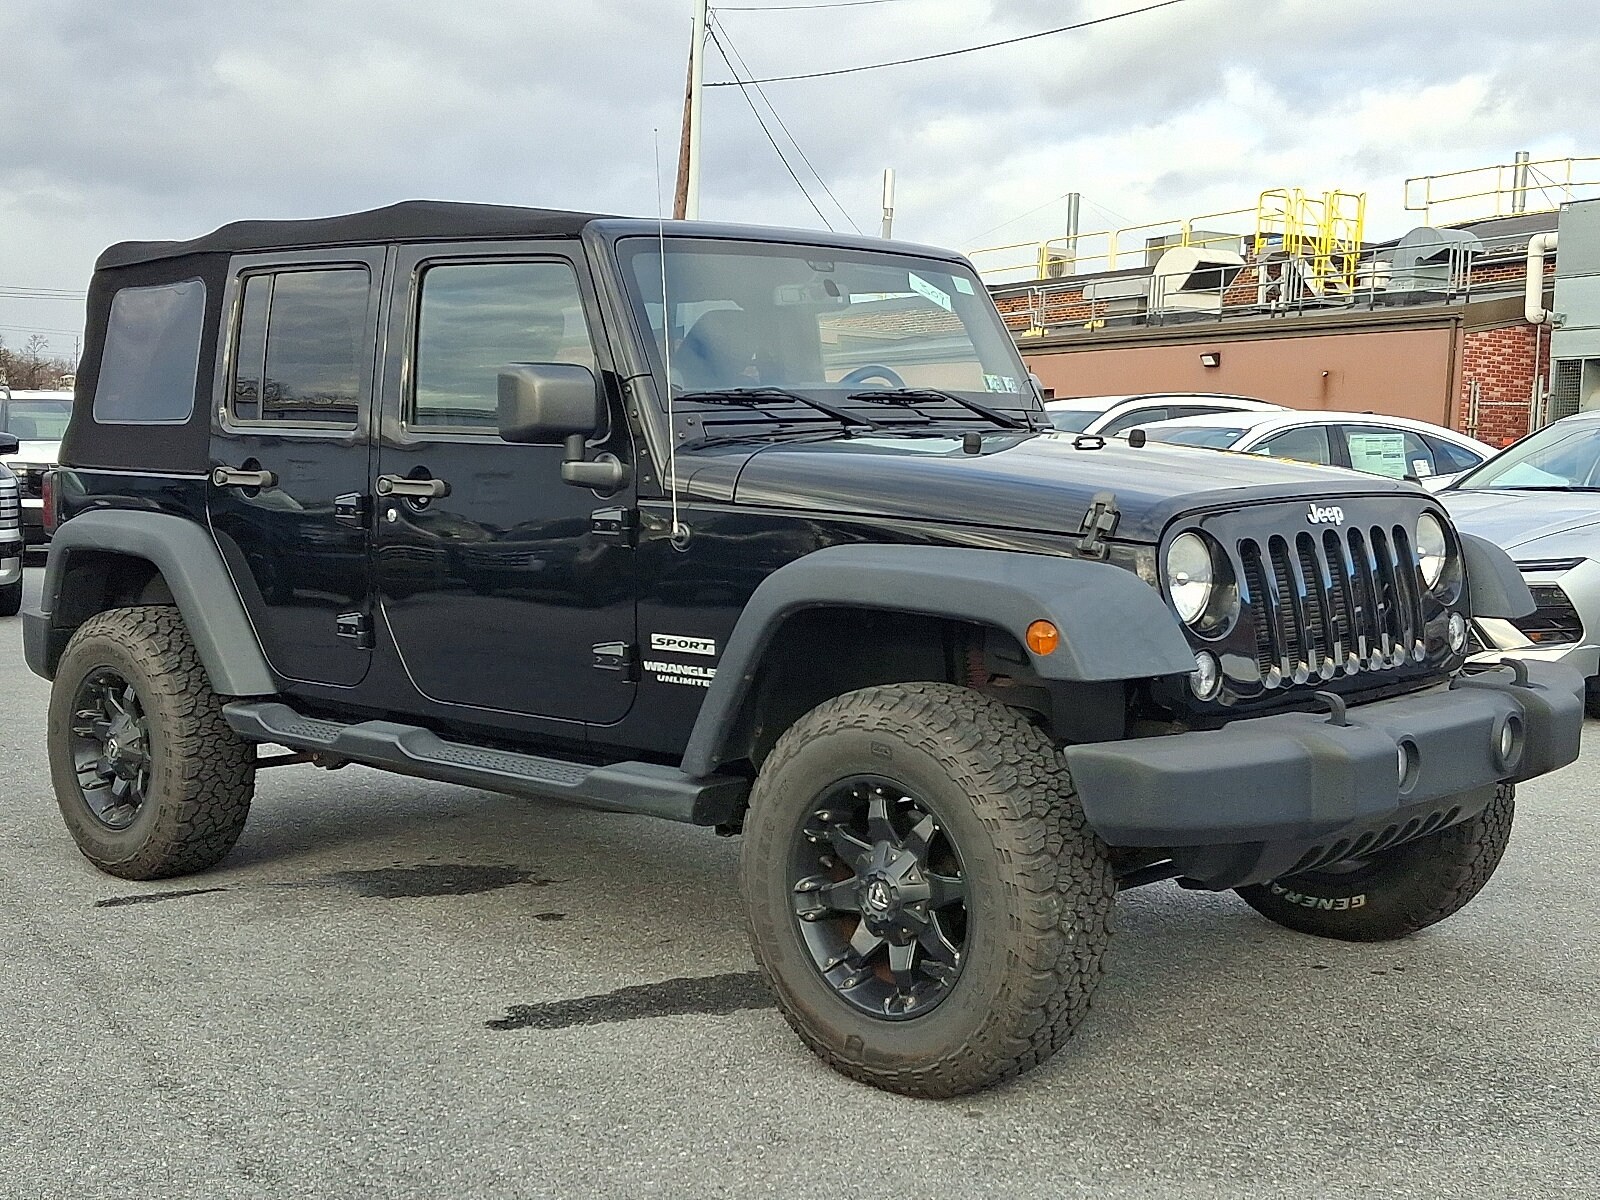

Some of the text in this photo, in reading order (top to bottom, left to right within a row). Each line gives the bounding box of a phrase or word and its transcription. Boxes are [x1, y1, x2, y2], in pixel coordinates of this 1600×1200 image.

[1306, 503, 1344, 526] Jeep
[652, 637, 715, 651] SPORT
[656, 674, 712, 688] UNLIMITE
[1268, 881, 1366, 910] GENERA
